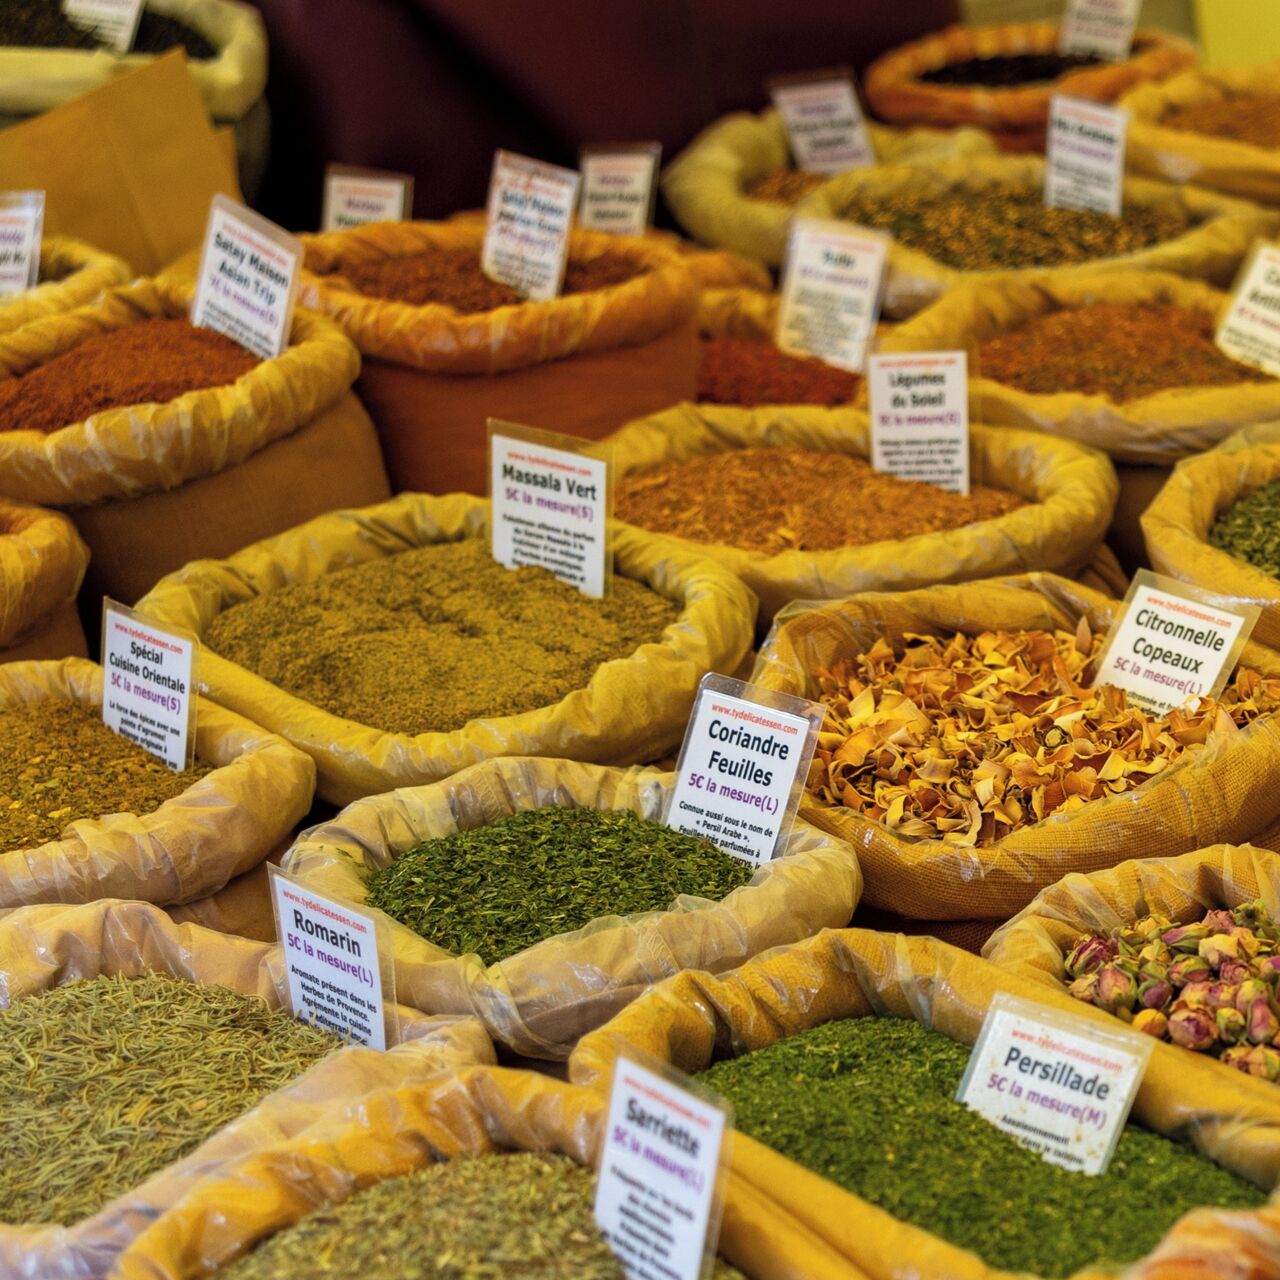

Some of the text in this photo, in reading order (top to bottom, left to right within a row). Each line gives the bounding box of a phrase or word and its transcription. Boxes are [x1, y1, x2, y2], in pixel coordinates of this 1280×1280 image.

[889, 373, 946, 391] Légumes
[501, 462, 597, 501] Massala Vert
[1134, 607, 1225, 652] Citronnelle
[108, 650, 186, 695] Cuisine Orientale
[129, 639, 164, 665] Spécial
[1131, 636, 1204, 674] Copeaux
[707, 718, 789, 761] Coriandre
[710, 702, 799, 736] www.tydelicatessen.com
[706, 749, 773, 787] Feuilles
[687, 771, 779, 816] 5€ la mesure(L)
[678, 799, 773, 838] Connue aussi sous le nom de
[292, 907, 362, 958] Romarin
[290, 963, 377, 1014] Aromate présent dans les
[1002, 1045, 1110, 1101] Persillade
[625, 1096, 699, 1156] Sarriette
